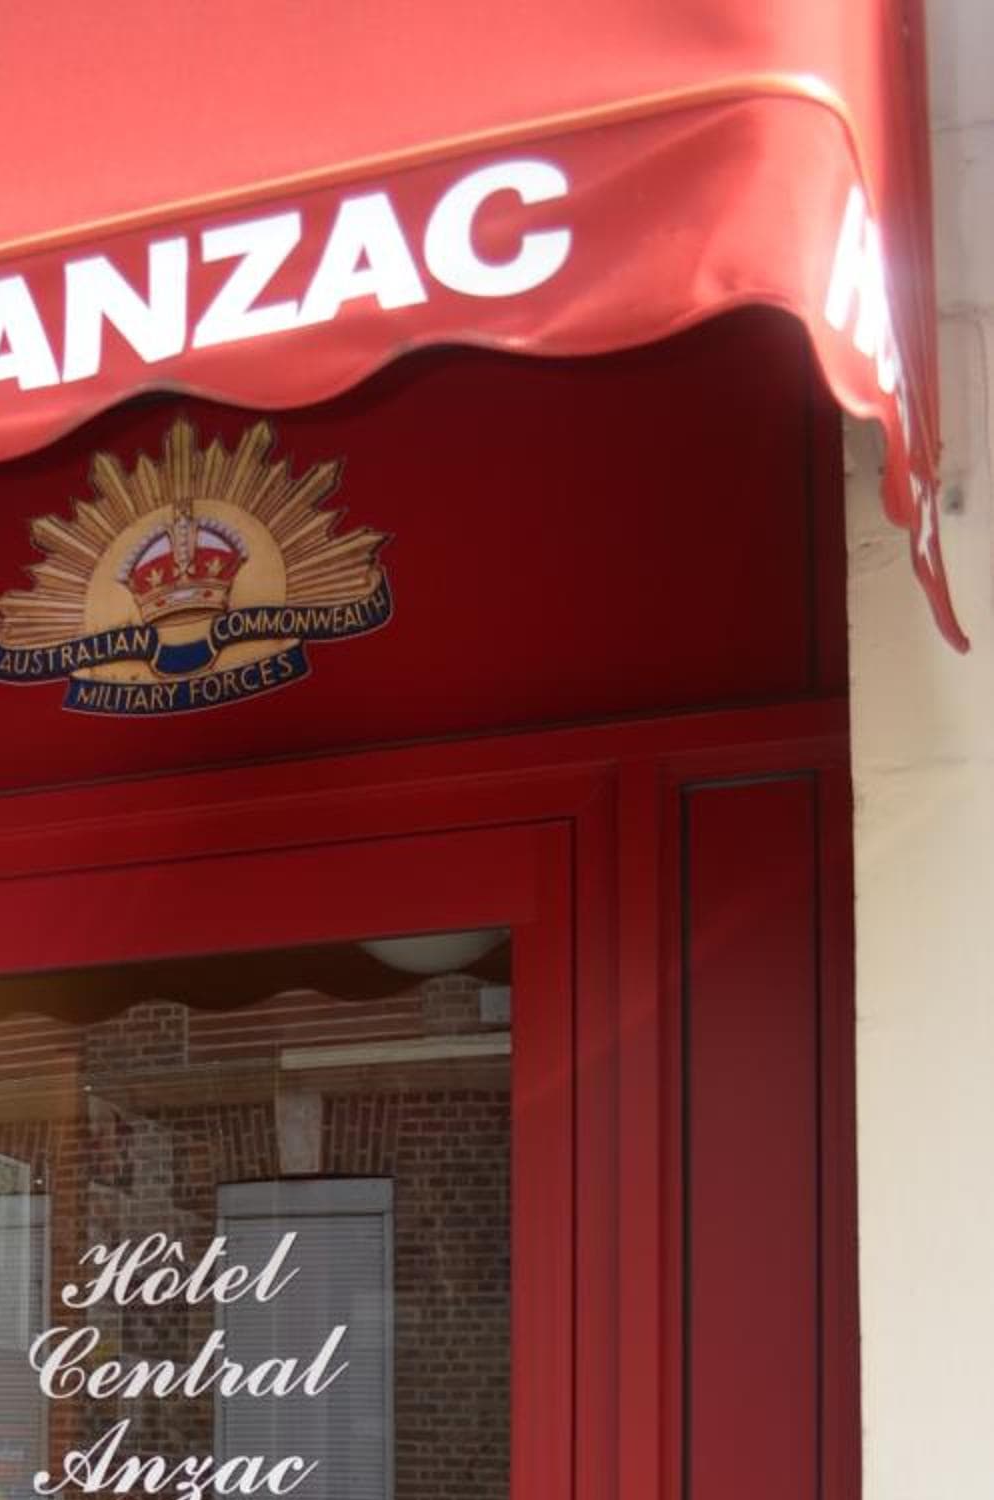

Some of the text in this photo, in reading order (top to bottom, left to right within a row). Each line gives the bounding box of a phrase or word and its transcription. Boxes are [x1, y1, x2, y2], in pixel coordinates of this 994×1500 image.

[212, 594, 387, 641] COMMONWEALTH
[76, 653, 294, 711] MILITARY FORCES
[61, 1231, 301, 1308] Hôtel
[28, 1325, 350, 1399] Central
